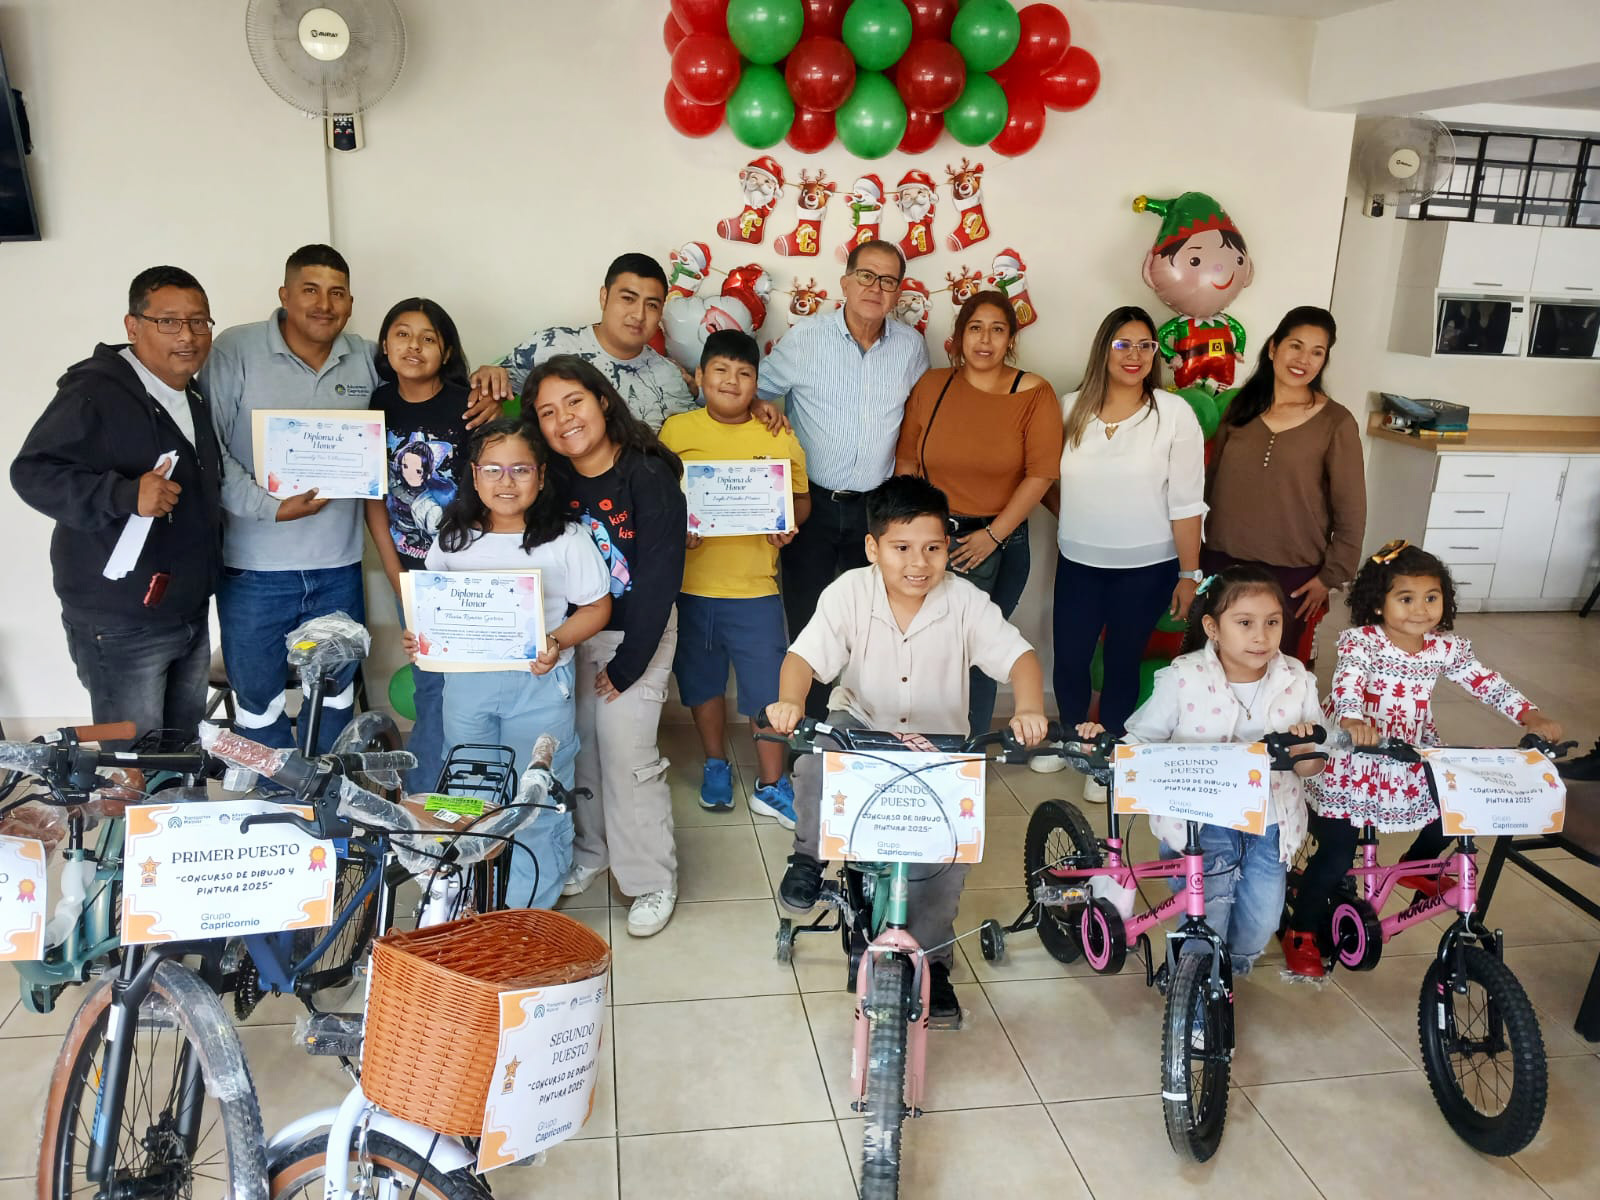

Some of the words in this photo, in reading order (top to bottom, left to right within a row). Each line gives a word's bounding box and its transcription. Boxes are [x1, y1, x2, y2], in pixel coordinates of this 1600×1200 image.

[303, 432, 334, 443] Diploma
[335, 433, 345, 442] de
[312, 441, 337, 450] Honor
[717, 475, 744, 486] Diploma
[744, 475, 753, 484] de
[725, 483, 747, 491] Honor
[450, 588, 484, 600] Diploma
[484, 589, 495, 599] de
[461, 598, 487, 608] Honor
[1164, 758, 1219, 768] SEGUNDO
[1170, 767, 1215, 775] PUESTO
[1204, 779, 1231, 787] DIBUJO
[874, 783, 932, 796] SEGUNDO
[880, 797, 927, 808] PUESTO
[1485, 796, 1514, 804] PINTURA
[1169, 805, 1214, 819] Capricornio
[914, 815, 942, 823] DIBUJO
[873, 824, 906, 832] PINTURA
[1492, 821, 1529, 830] Capricornio
[877, 841, 901, 850] Grupo
[171, 848, 235, 864] PRIMER
[238, 843, 300, 860] PUESTO
[877, 848, 924, 858] Capricornio
[236, 870, 248, 879] DE
[251, 867, 286, 878] DIBUJO
[196, 884, 239, 896] PINTURA
[200, 912, 231, 922] Grupo
[200, 917, 260, 931] Capricornio
[549, 1022, 595, 1048] SEGUNDO
[552, 1042, 589, 1065] PUESTO
[567, 1069, 575, 1080] DE
[538, 1087, 567, 1105] PINTURA
[537, 1118, 558, 1132] Grupo
[535, 1121, 573, 1143] Capricornio
